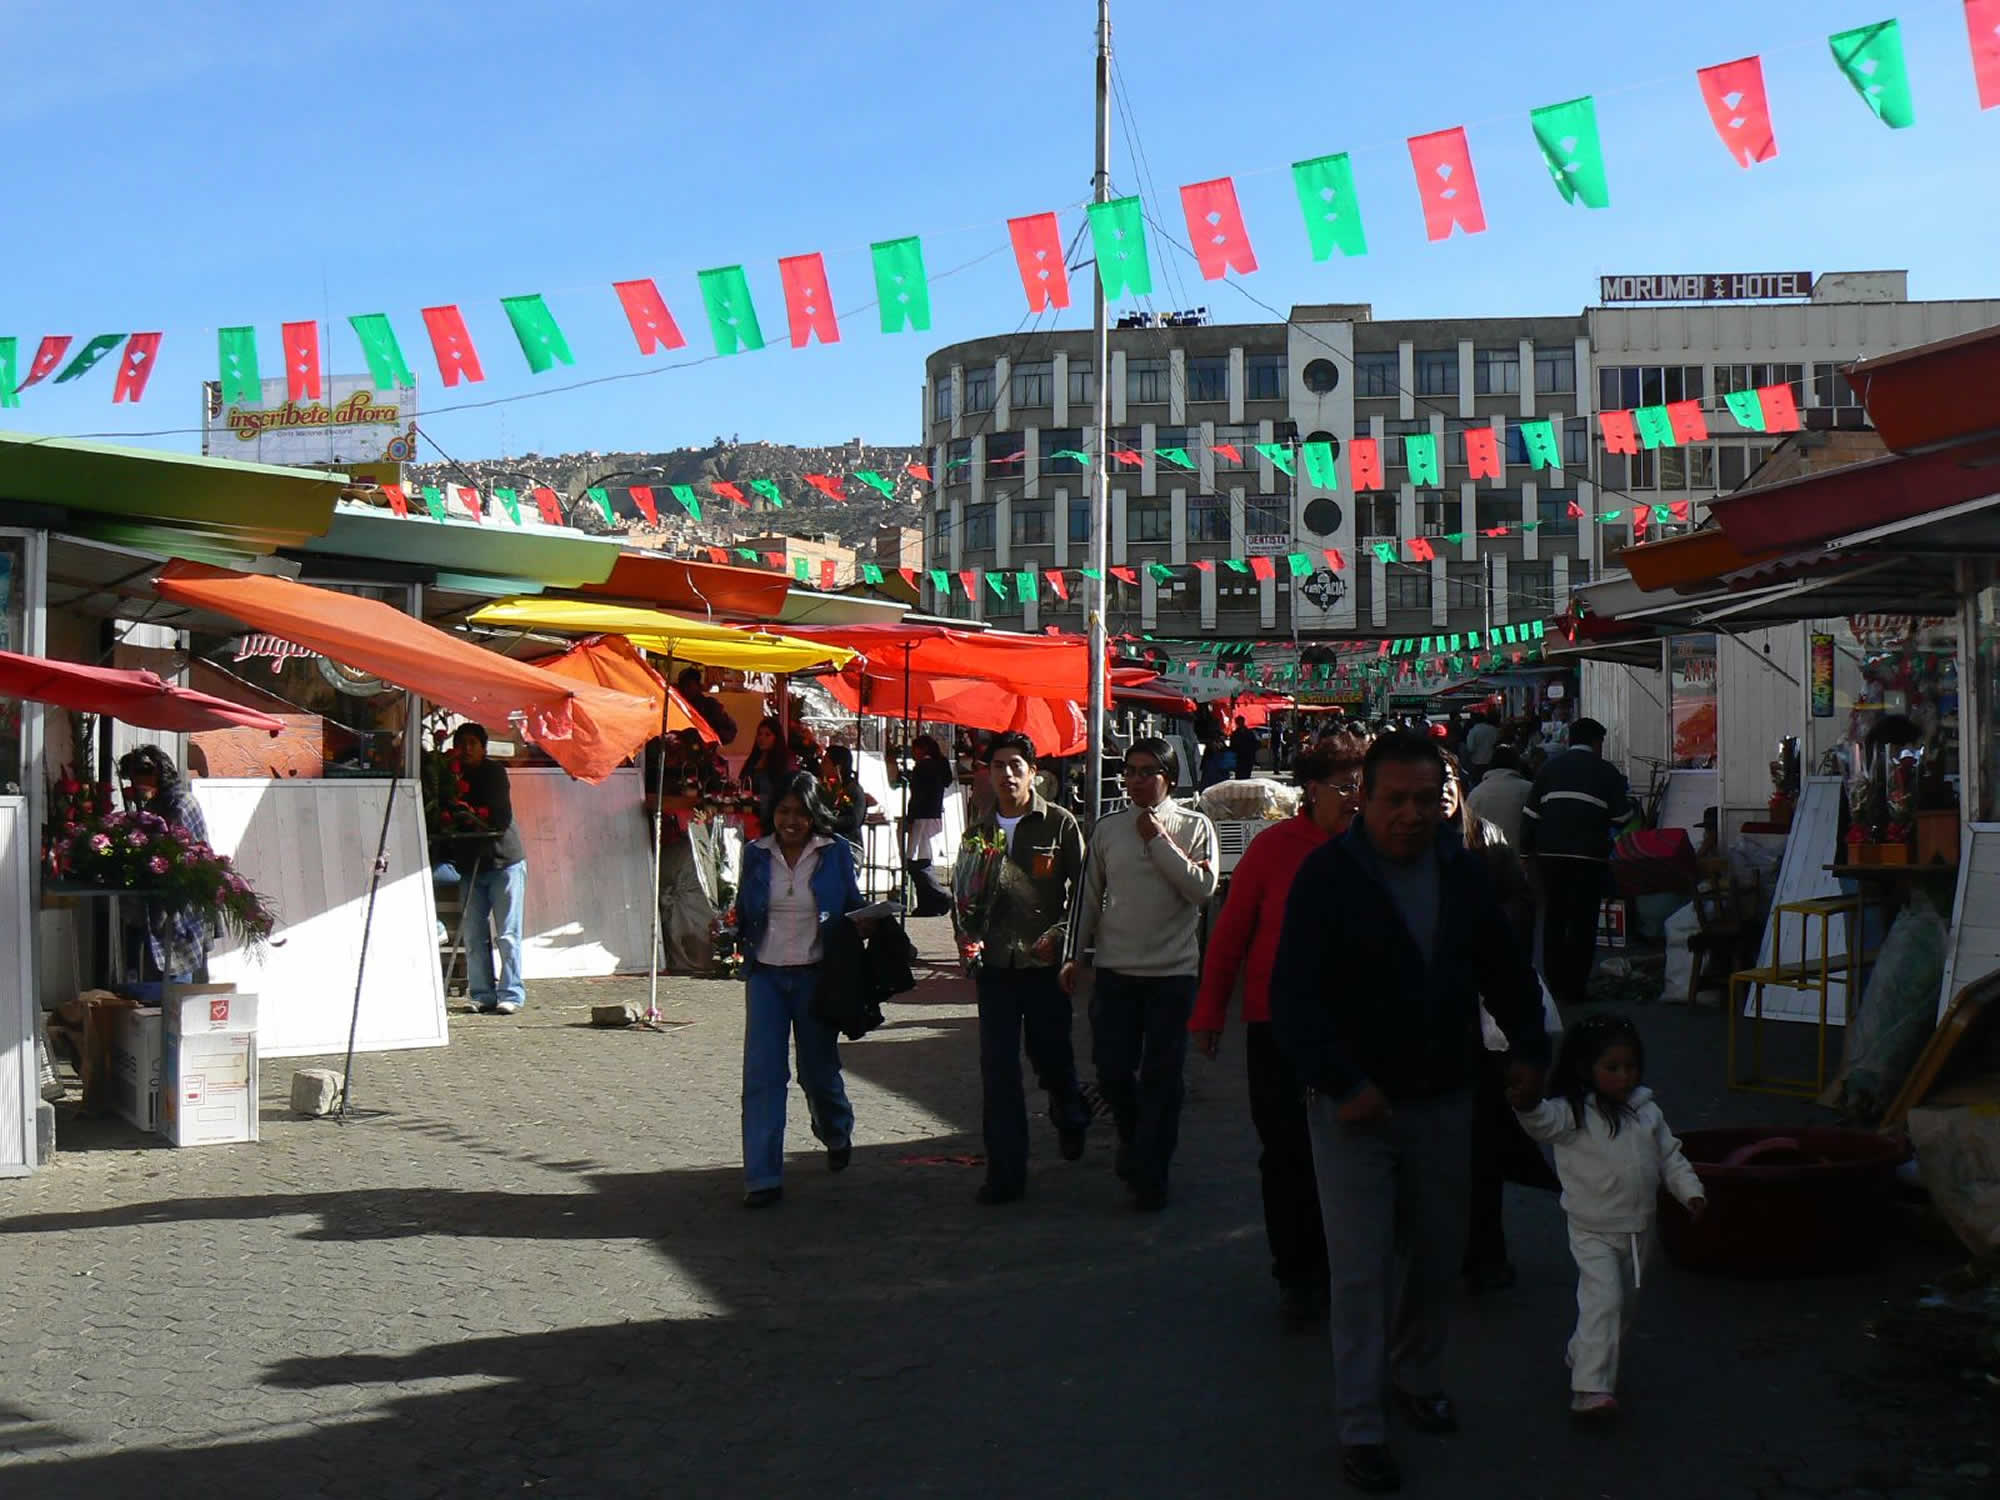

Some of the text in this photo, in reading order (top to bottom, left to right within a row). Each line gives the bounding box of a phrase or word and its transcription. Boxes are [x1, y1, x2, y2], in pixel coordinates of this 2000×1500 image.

[1602, 273, 1808, 300] MORUMBI HOTEL
[335, 391, 397, 423] ahora
[1248, 535, 1286, 545] DENTISTA
